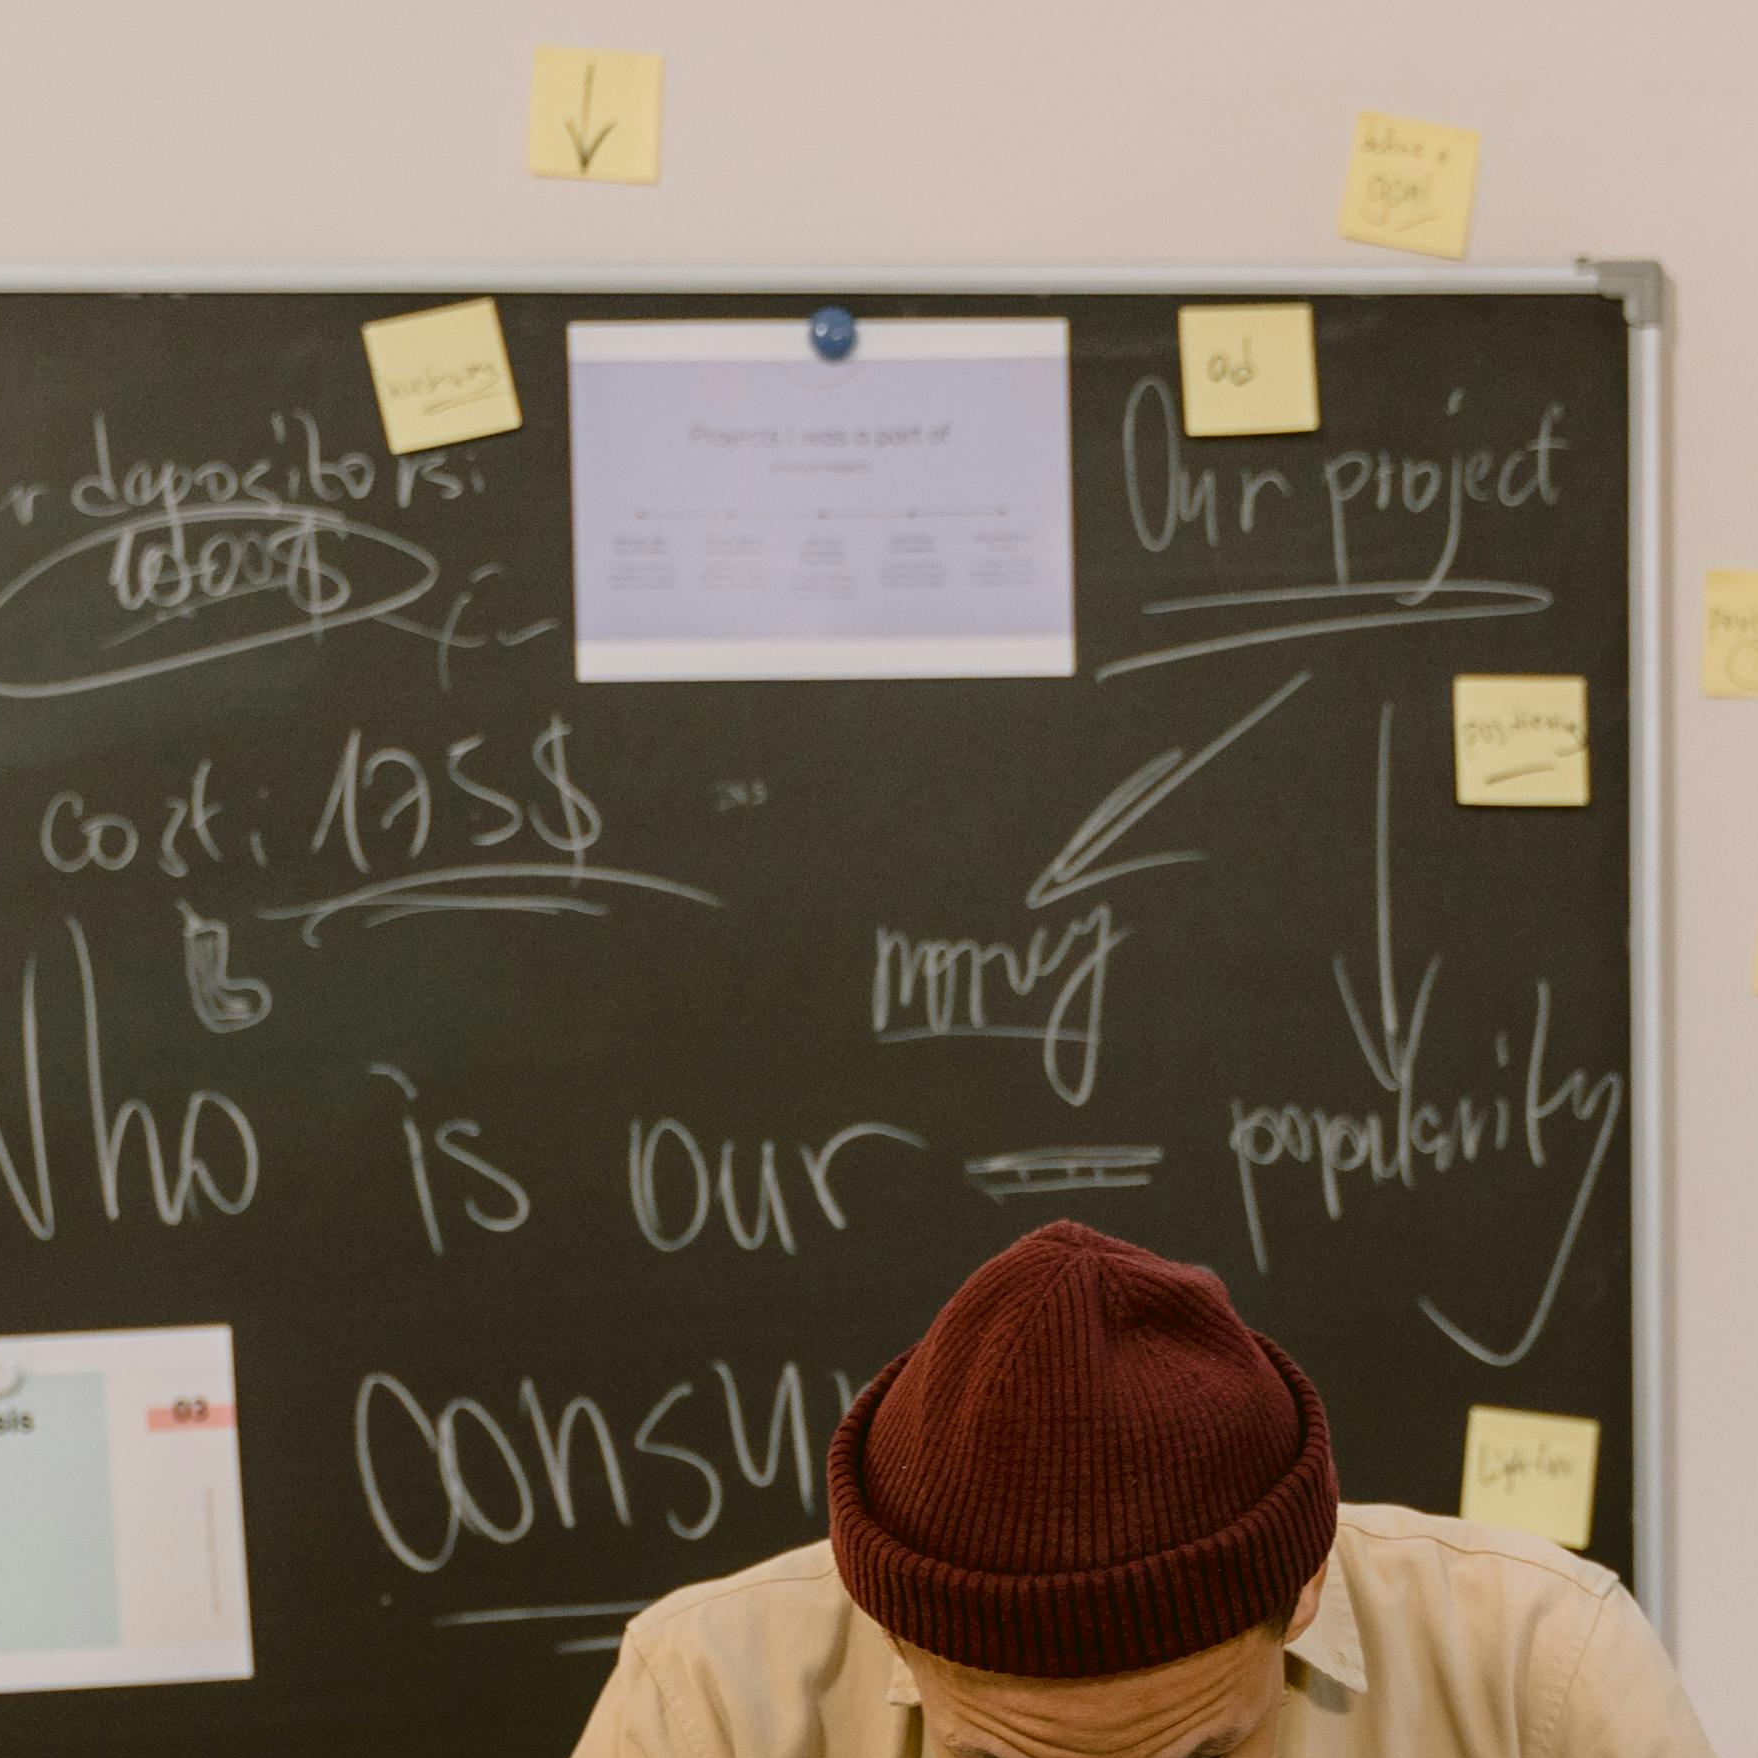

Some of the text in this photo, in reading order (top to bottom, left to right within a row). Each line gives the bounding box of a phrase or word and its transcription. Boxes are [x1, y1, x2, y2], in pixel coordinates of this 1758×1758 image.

[689, 423, 779, 452] Projects
[1122, 374, 1572, 606] Our project
[310, 714, 604, 886] 175$
[368, 1061, 531, 1257] is
